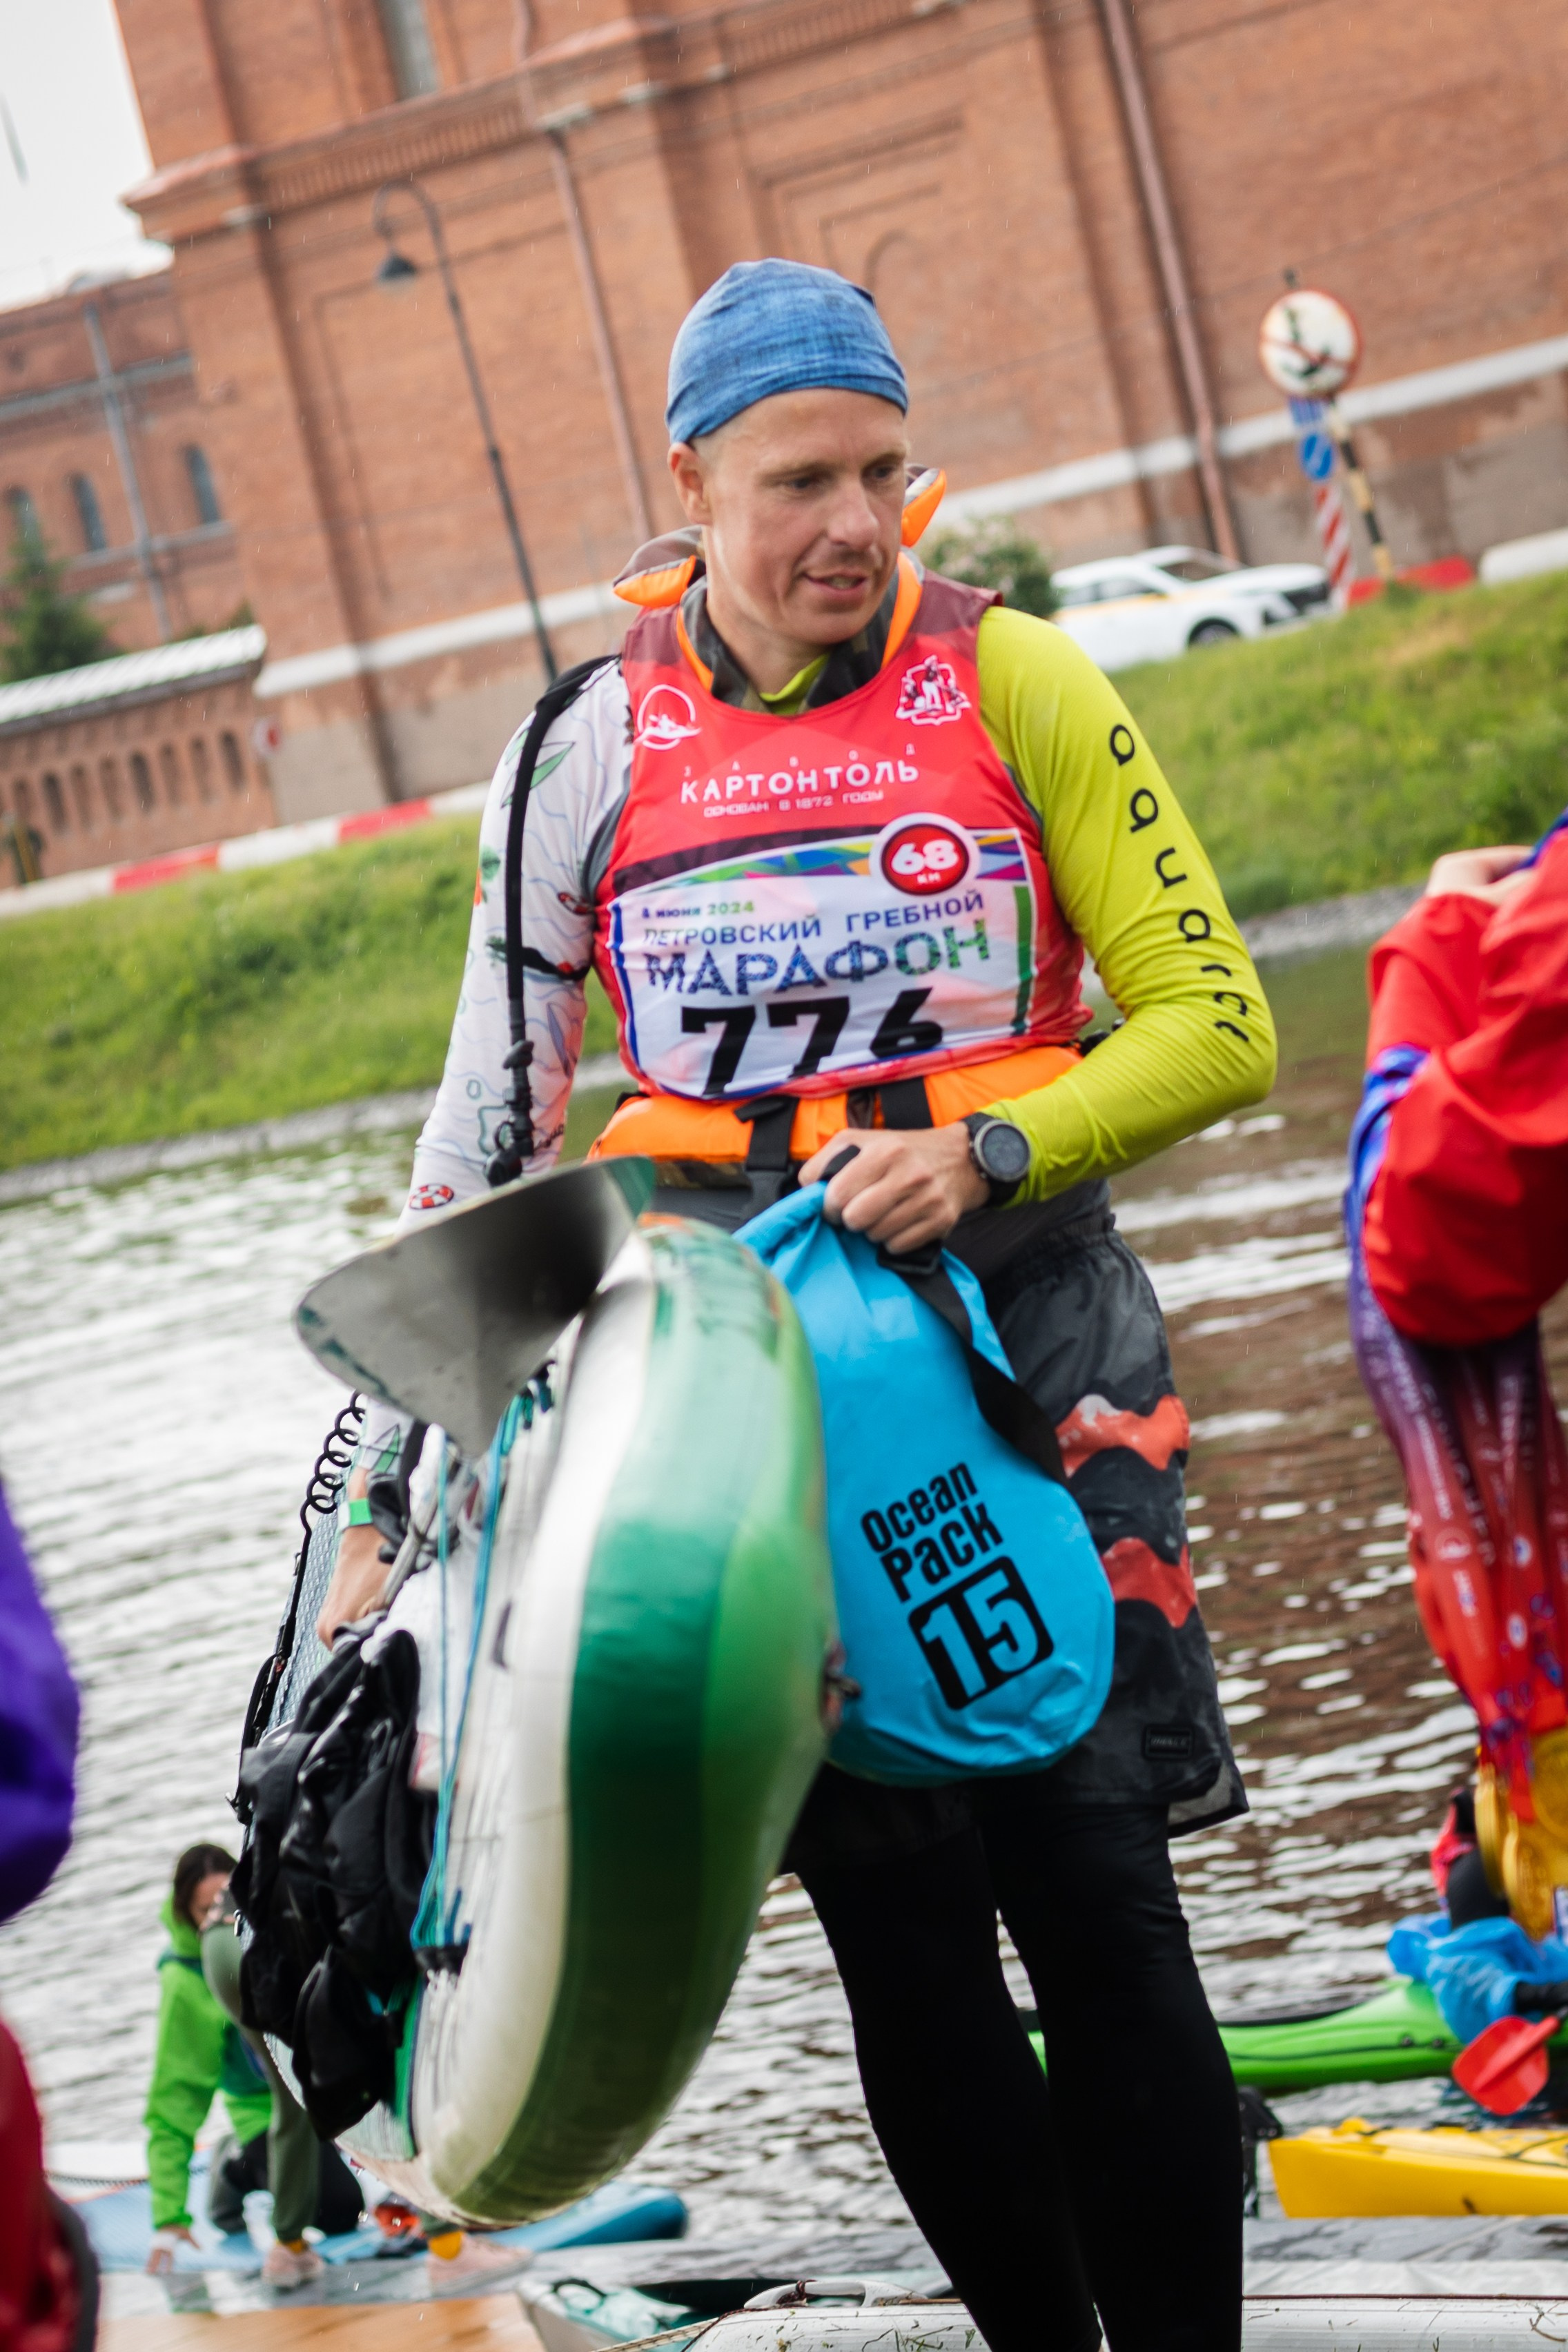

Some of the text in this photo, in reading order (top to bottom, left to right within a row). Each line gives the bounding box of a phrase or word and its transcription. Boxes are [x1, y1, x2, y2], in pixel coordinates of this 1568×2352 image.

[680, 760, 919, 804] КАРТОНТОЛЬ
[795, 794, 834, 810] 1872
[891, 839, 959, 875] 68
[643, 889, 984, 947] ПЕТРОВСКИЙ ГРЕБНОЙ
[708, 901, 754, 915] 2024
[643, 917, 990, 997] МАРАФОН
[681, 987, 943, 1096] 776
[860, 1460, 979, 1554] Ocean
[879, 1501, 1003, 1604] Pack
[919, 1567, 1039, 1699] 15
